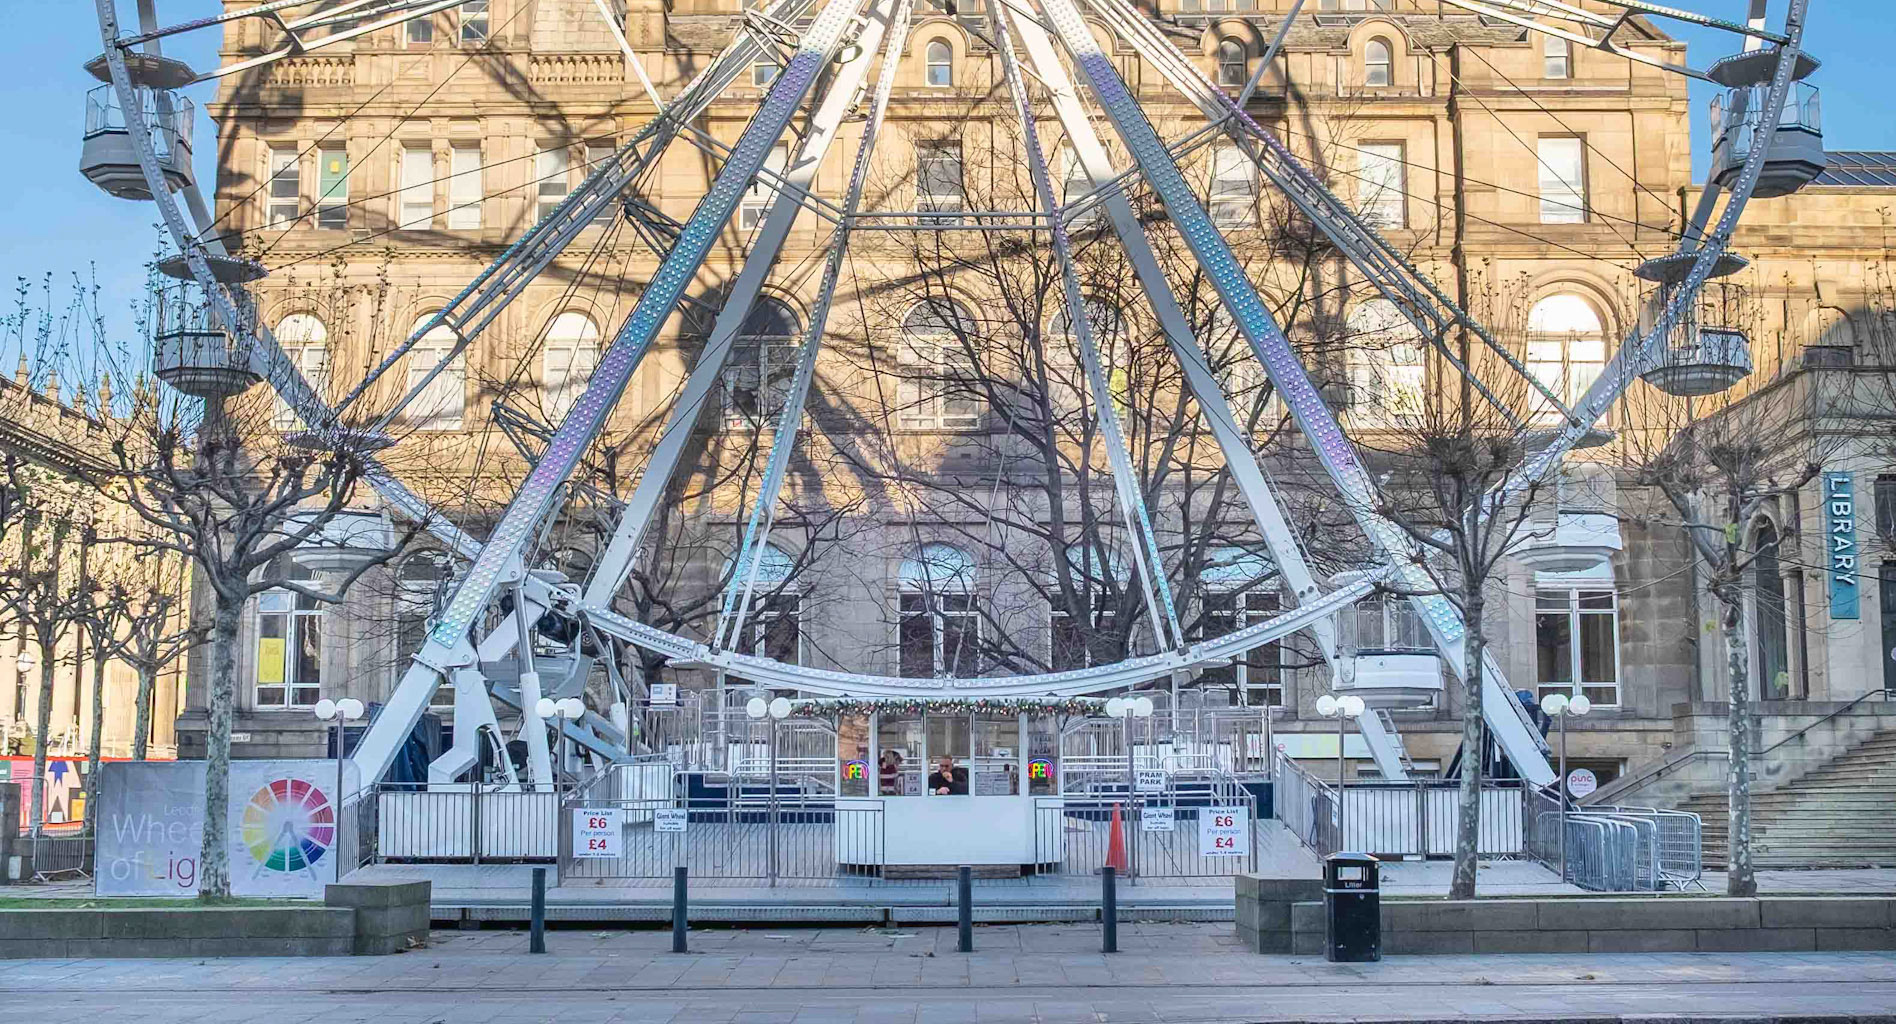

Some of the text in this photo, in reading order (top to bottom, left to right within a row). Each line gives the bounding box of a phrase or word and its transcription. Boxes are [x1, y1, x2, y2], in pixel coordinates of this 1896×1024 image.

[1830, 477, 1856, 586] LIBRARY
[842, 764, 869, 780] OPEN
[1028, 762, 1053, 779] OPEN
[588, 817, 607, 829] £6
[1215, 816, 1233, 827] £6
[112, 813, 204, 844] Whee
[593, 830, 615, 838] person
[1219, 828, 1241, 836] person
[588, 839, 607, 850] £4
[1215, 837, 1234, 848] £4
[111, 850, 196, 888] of Lig
